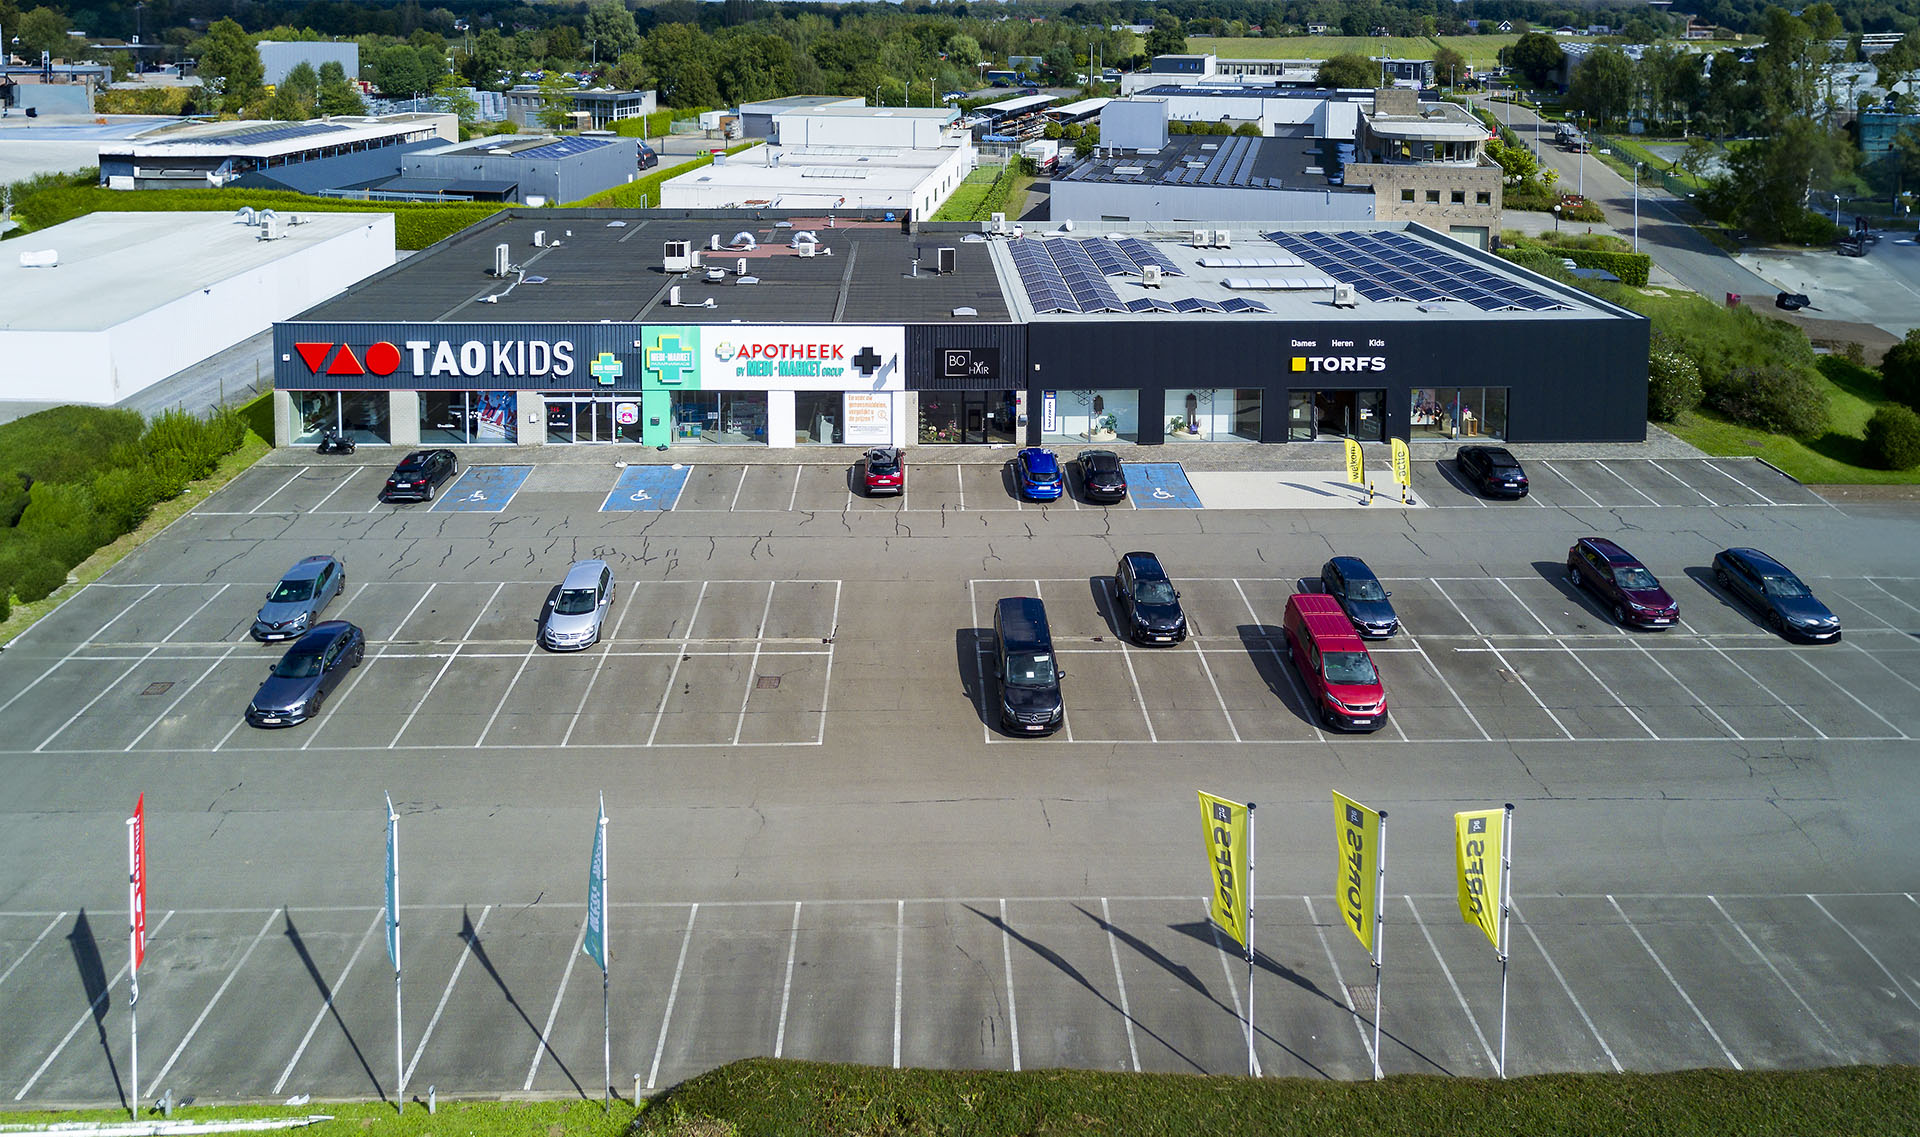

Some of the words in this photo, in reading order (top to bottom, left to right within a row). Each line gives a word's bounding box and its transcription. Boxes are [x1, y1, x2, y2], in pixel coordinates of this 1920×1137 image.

[736, 343, 844, 359] APOTHEEK
[1291, 339, 1317, 347] Dames
[1331, 339, 1354, 347] Heren
[1368, 339, 1385, 347] Kids
[949, 355, 966, 367] BO
[1308, 356, 1386, 372] TORFS
[736, 366, 745, 377] BY
[822, 367, 844, 377] GROUP
[1350, 446, 1359, 480] welkom
[1396, 451, 1406, 477] actie
